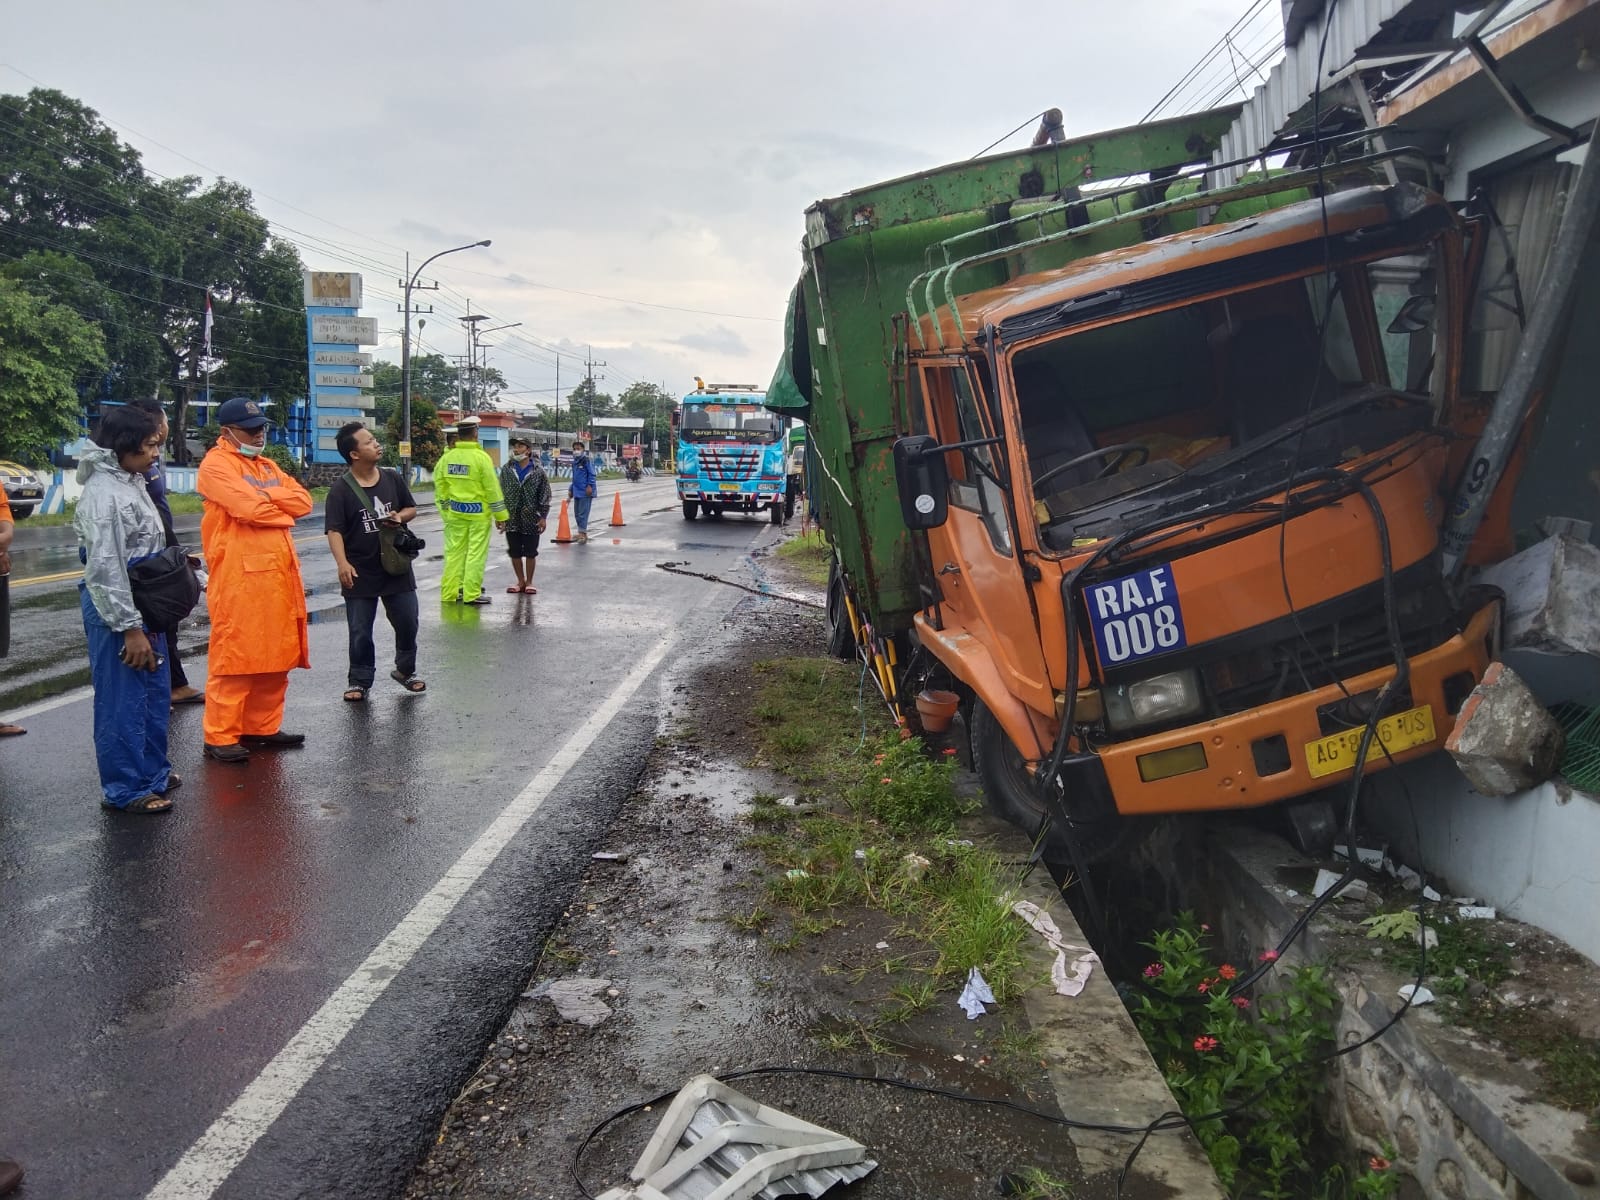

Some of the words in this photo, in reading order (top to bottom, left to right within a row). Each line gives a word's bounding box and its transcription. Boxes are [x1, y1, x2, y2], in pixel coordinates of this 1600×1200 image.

[1467, 457, 1490, 494] 9
[1095, 568, 1167, 619] RA.F
[1104, 605, 1179, 661] 008
[1317, 740, 1339, 764] AG
[1403, 711, 1426, 736] US
